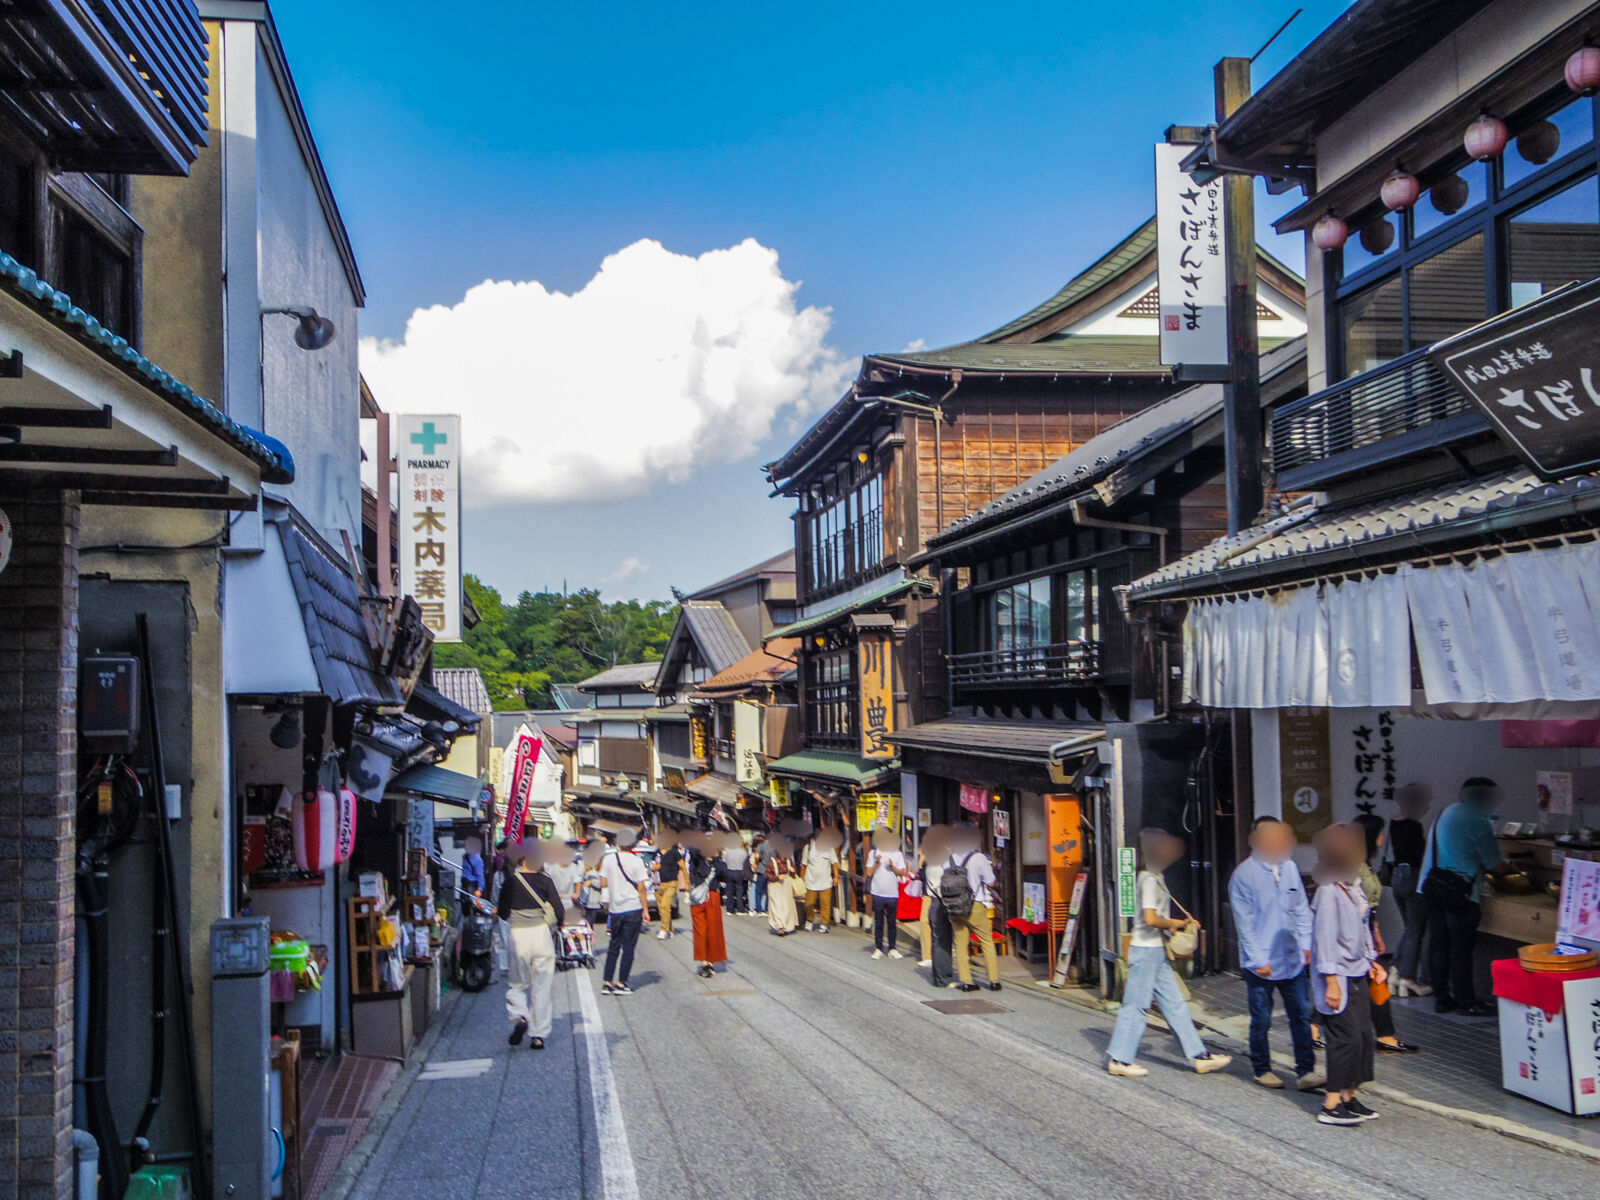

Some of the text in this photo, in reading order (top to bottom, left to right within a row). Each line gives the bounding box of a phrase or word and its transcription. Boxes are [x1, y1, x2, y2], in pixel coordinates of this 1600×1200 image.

[407, 460, 451, 470] PHARMACY
[412, 506, 447, 633] 木内薬局
[863, 636, 889, 755] 川豊
